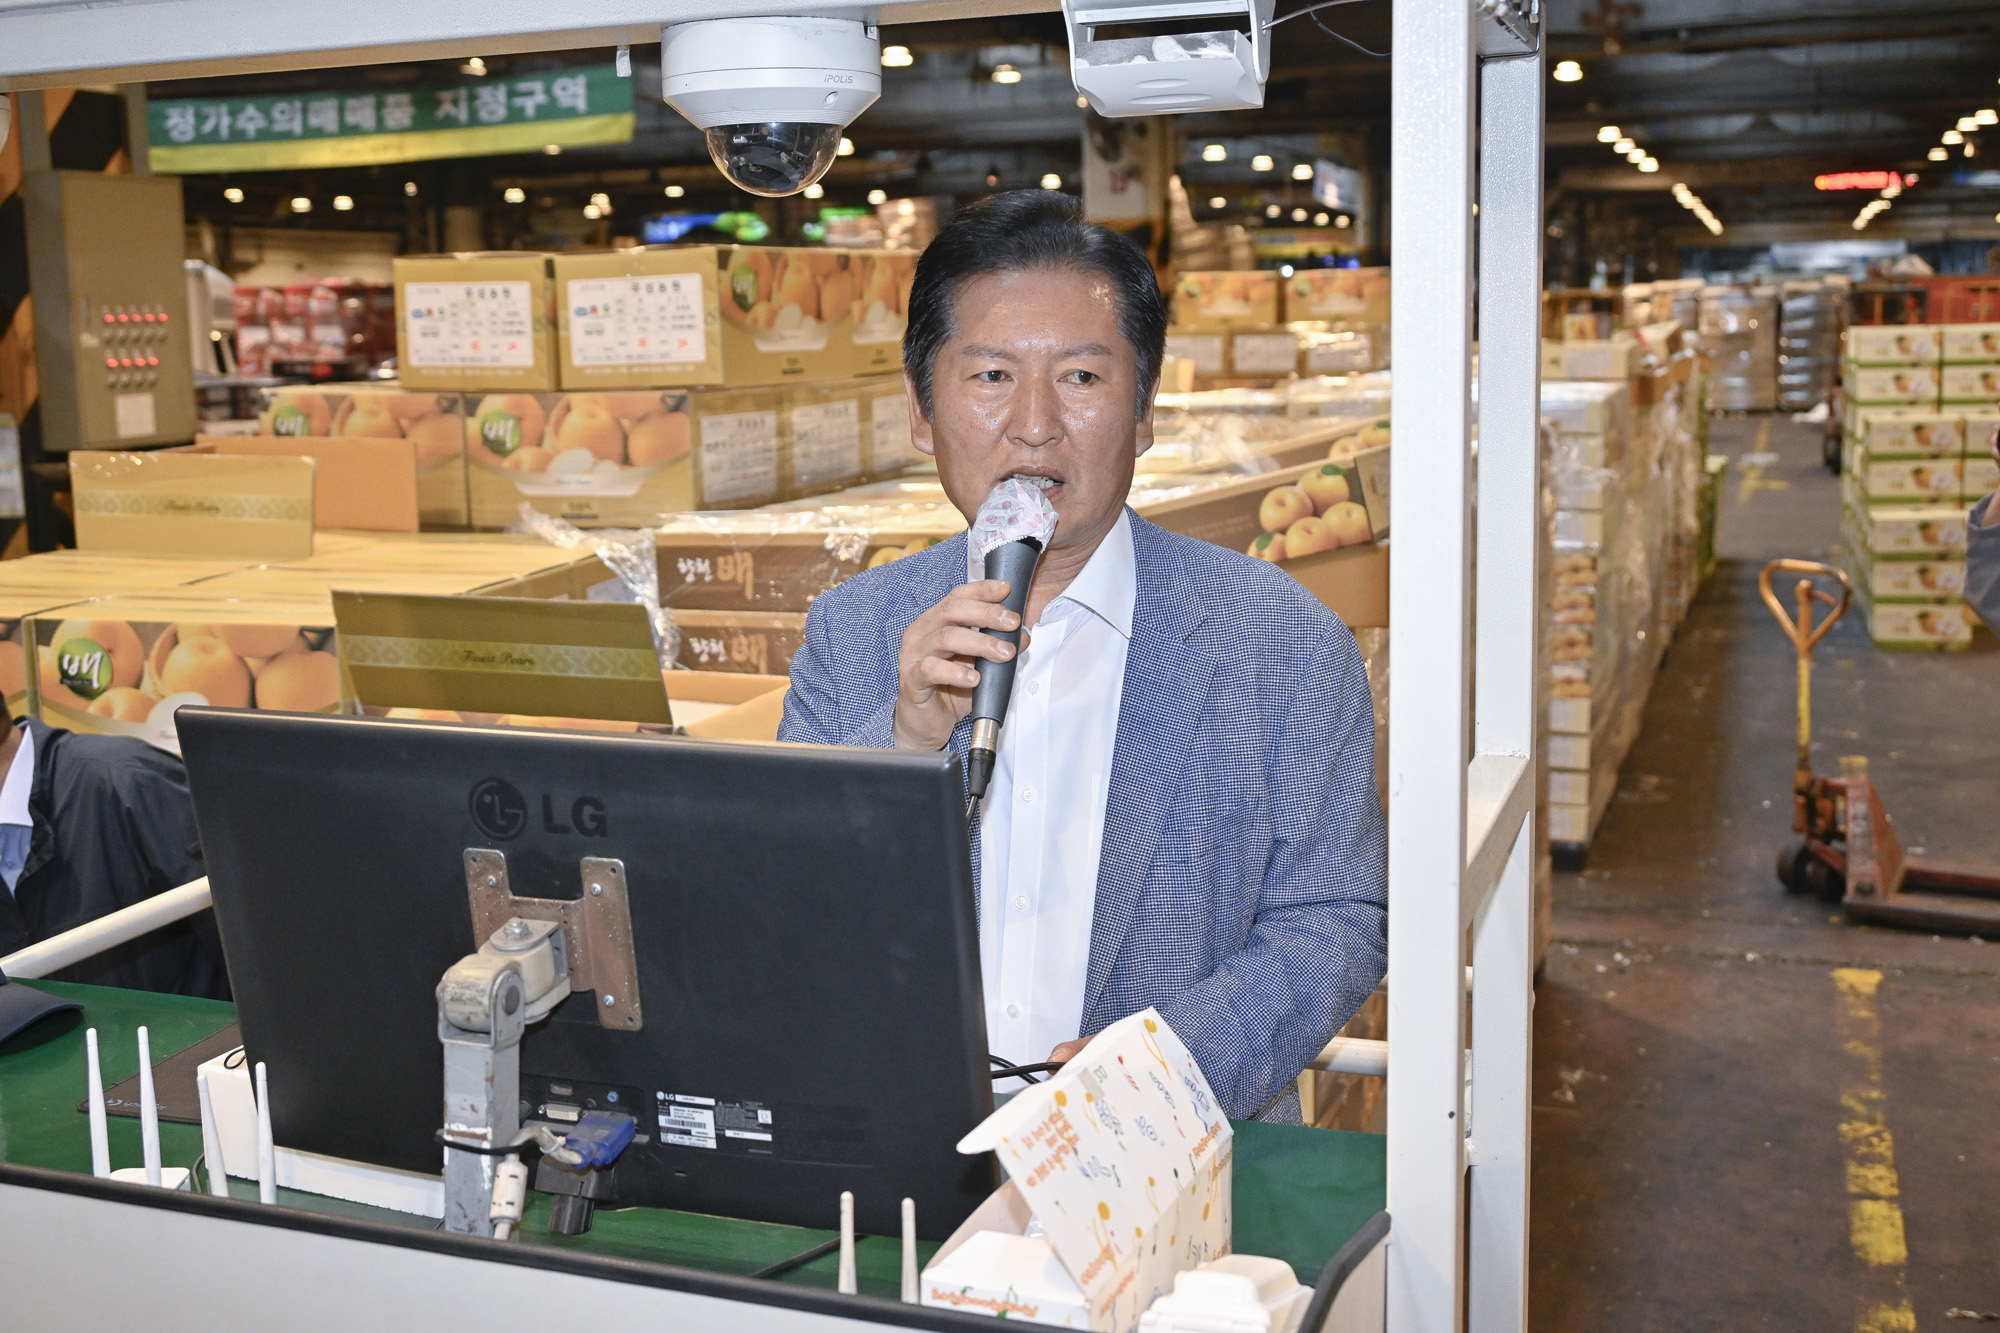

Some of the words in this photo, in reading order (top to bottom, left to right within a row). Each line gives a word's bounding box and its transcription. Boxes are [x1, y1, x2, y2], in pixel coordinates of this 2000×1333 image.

[435, 74, 587, 124] 지정구역
[716, 550, 754, 600] 배
[731, 633, 768, 675] 배
[541, 793, 608, 838] LG
[665, 1093, 675, 1101] LG
